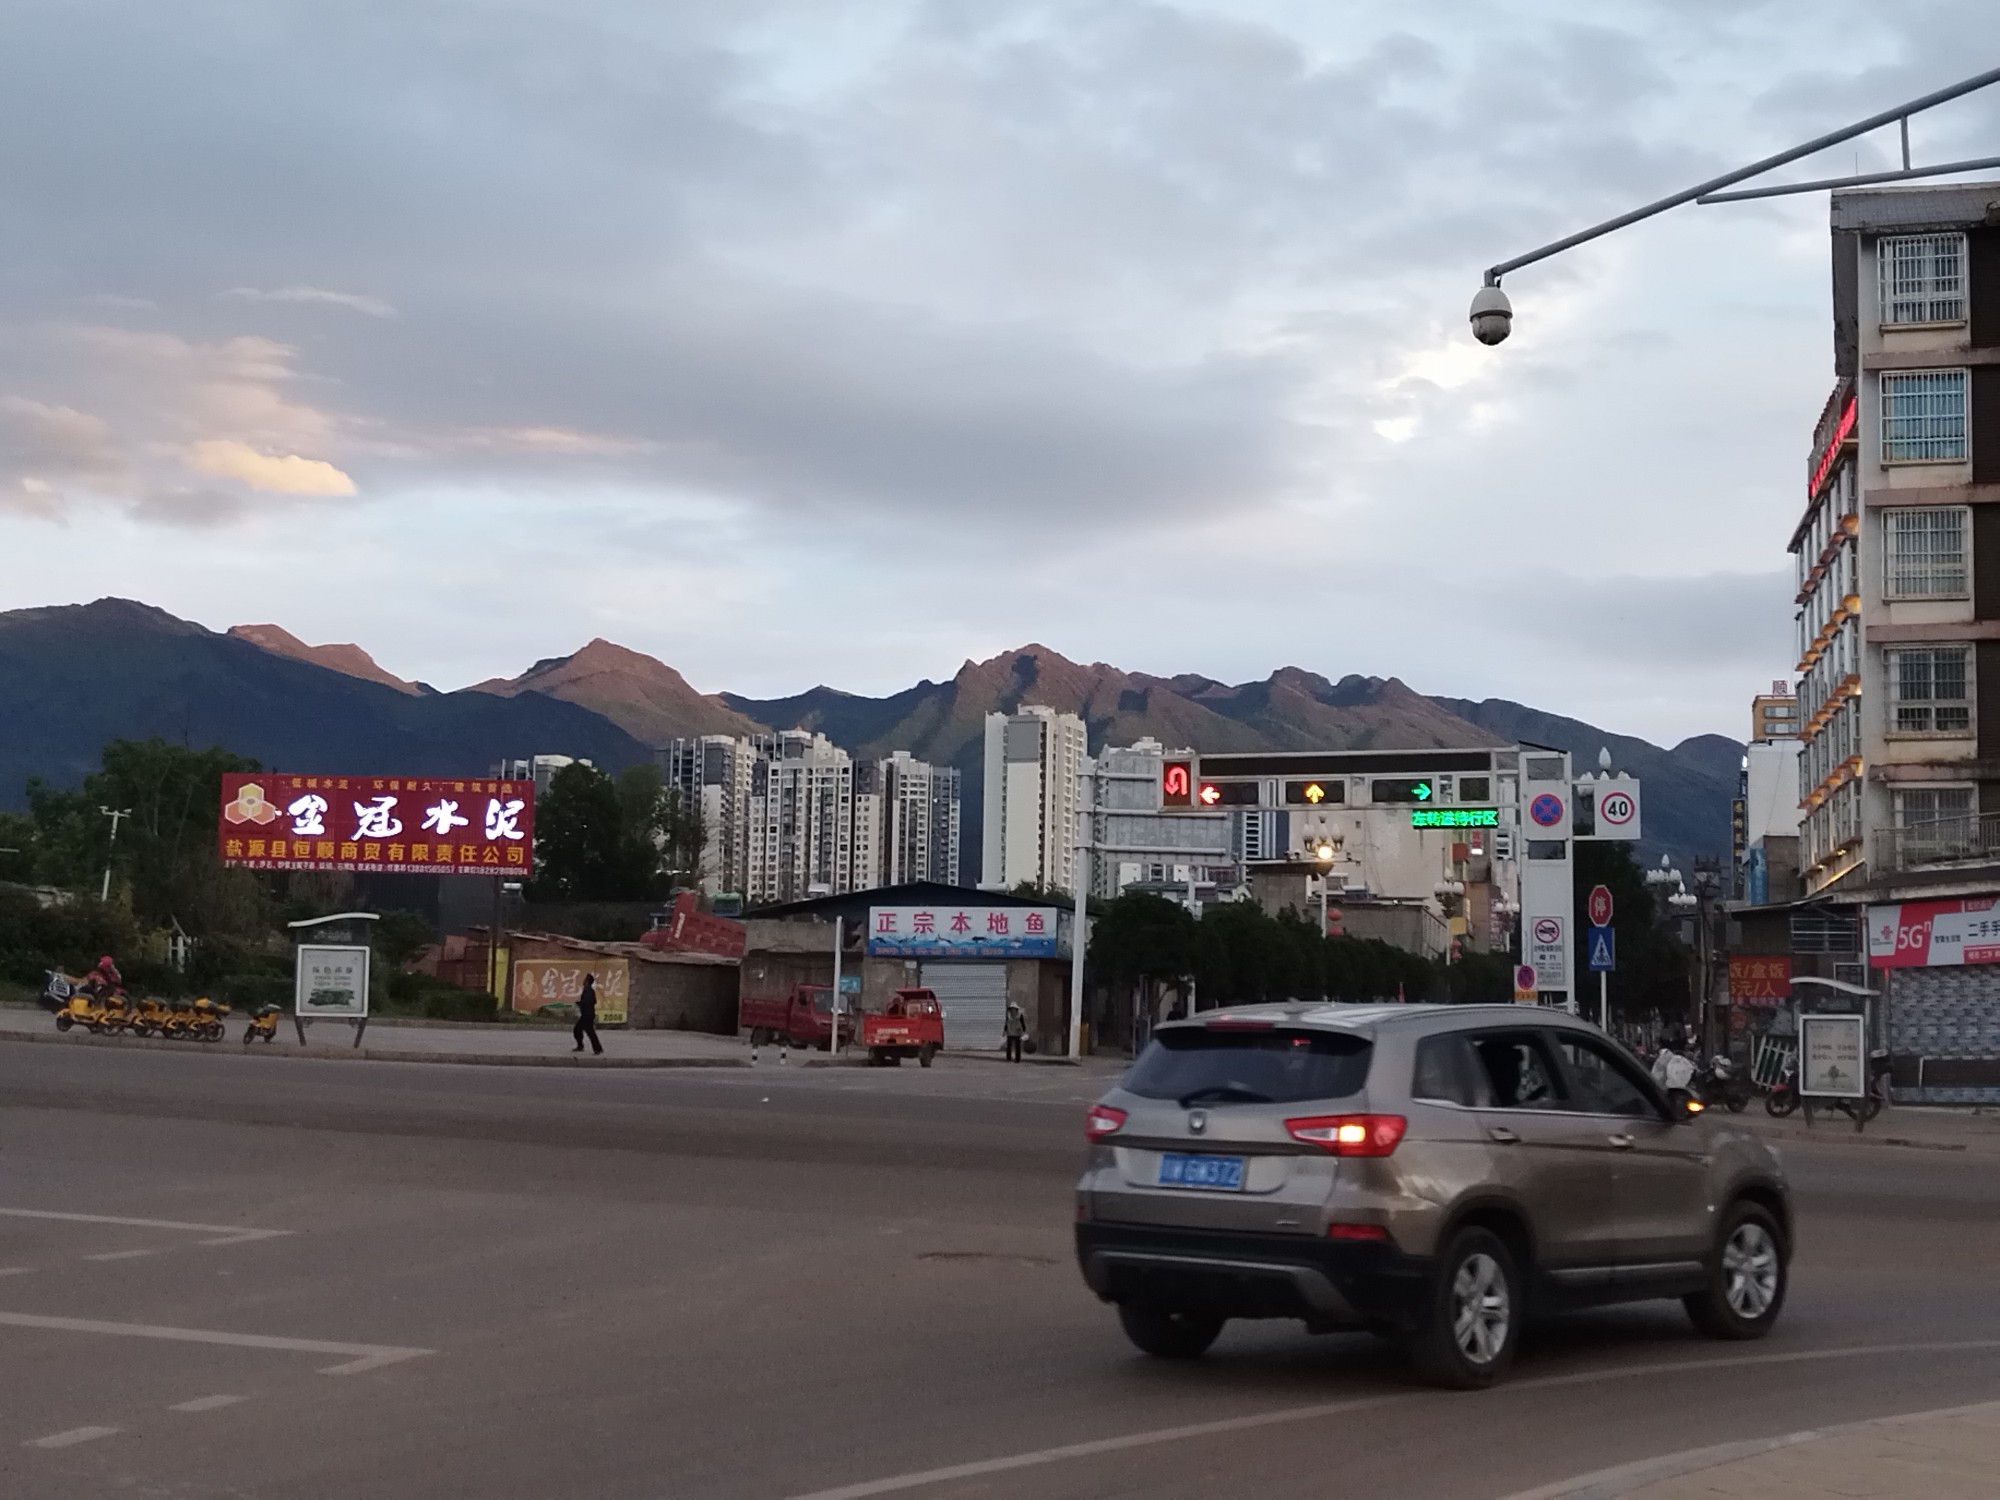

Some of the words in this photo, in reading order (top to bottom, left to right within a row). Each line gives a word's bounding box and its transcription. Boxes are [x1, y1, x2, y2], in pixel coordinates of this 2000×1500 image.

[287, 794, 525, 841] 金冠水泥
[1608, 800, 1627, 816] 40
[226, 839, 524, 864] 盐源县恒顺商贸有限责任公司
[1595, 895, 1606, 916] 停
[876, 911, 1045, 935] 正宗本地鱼
